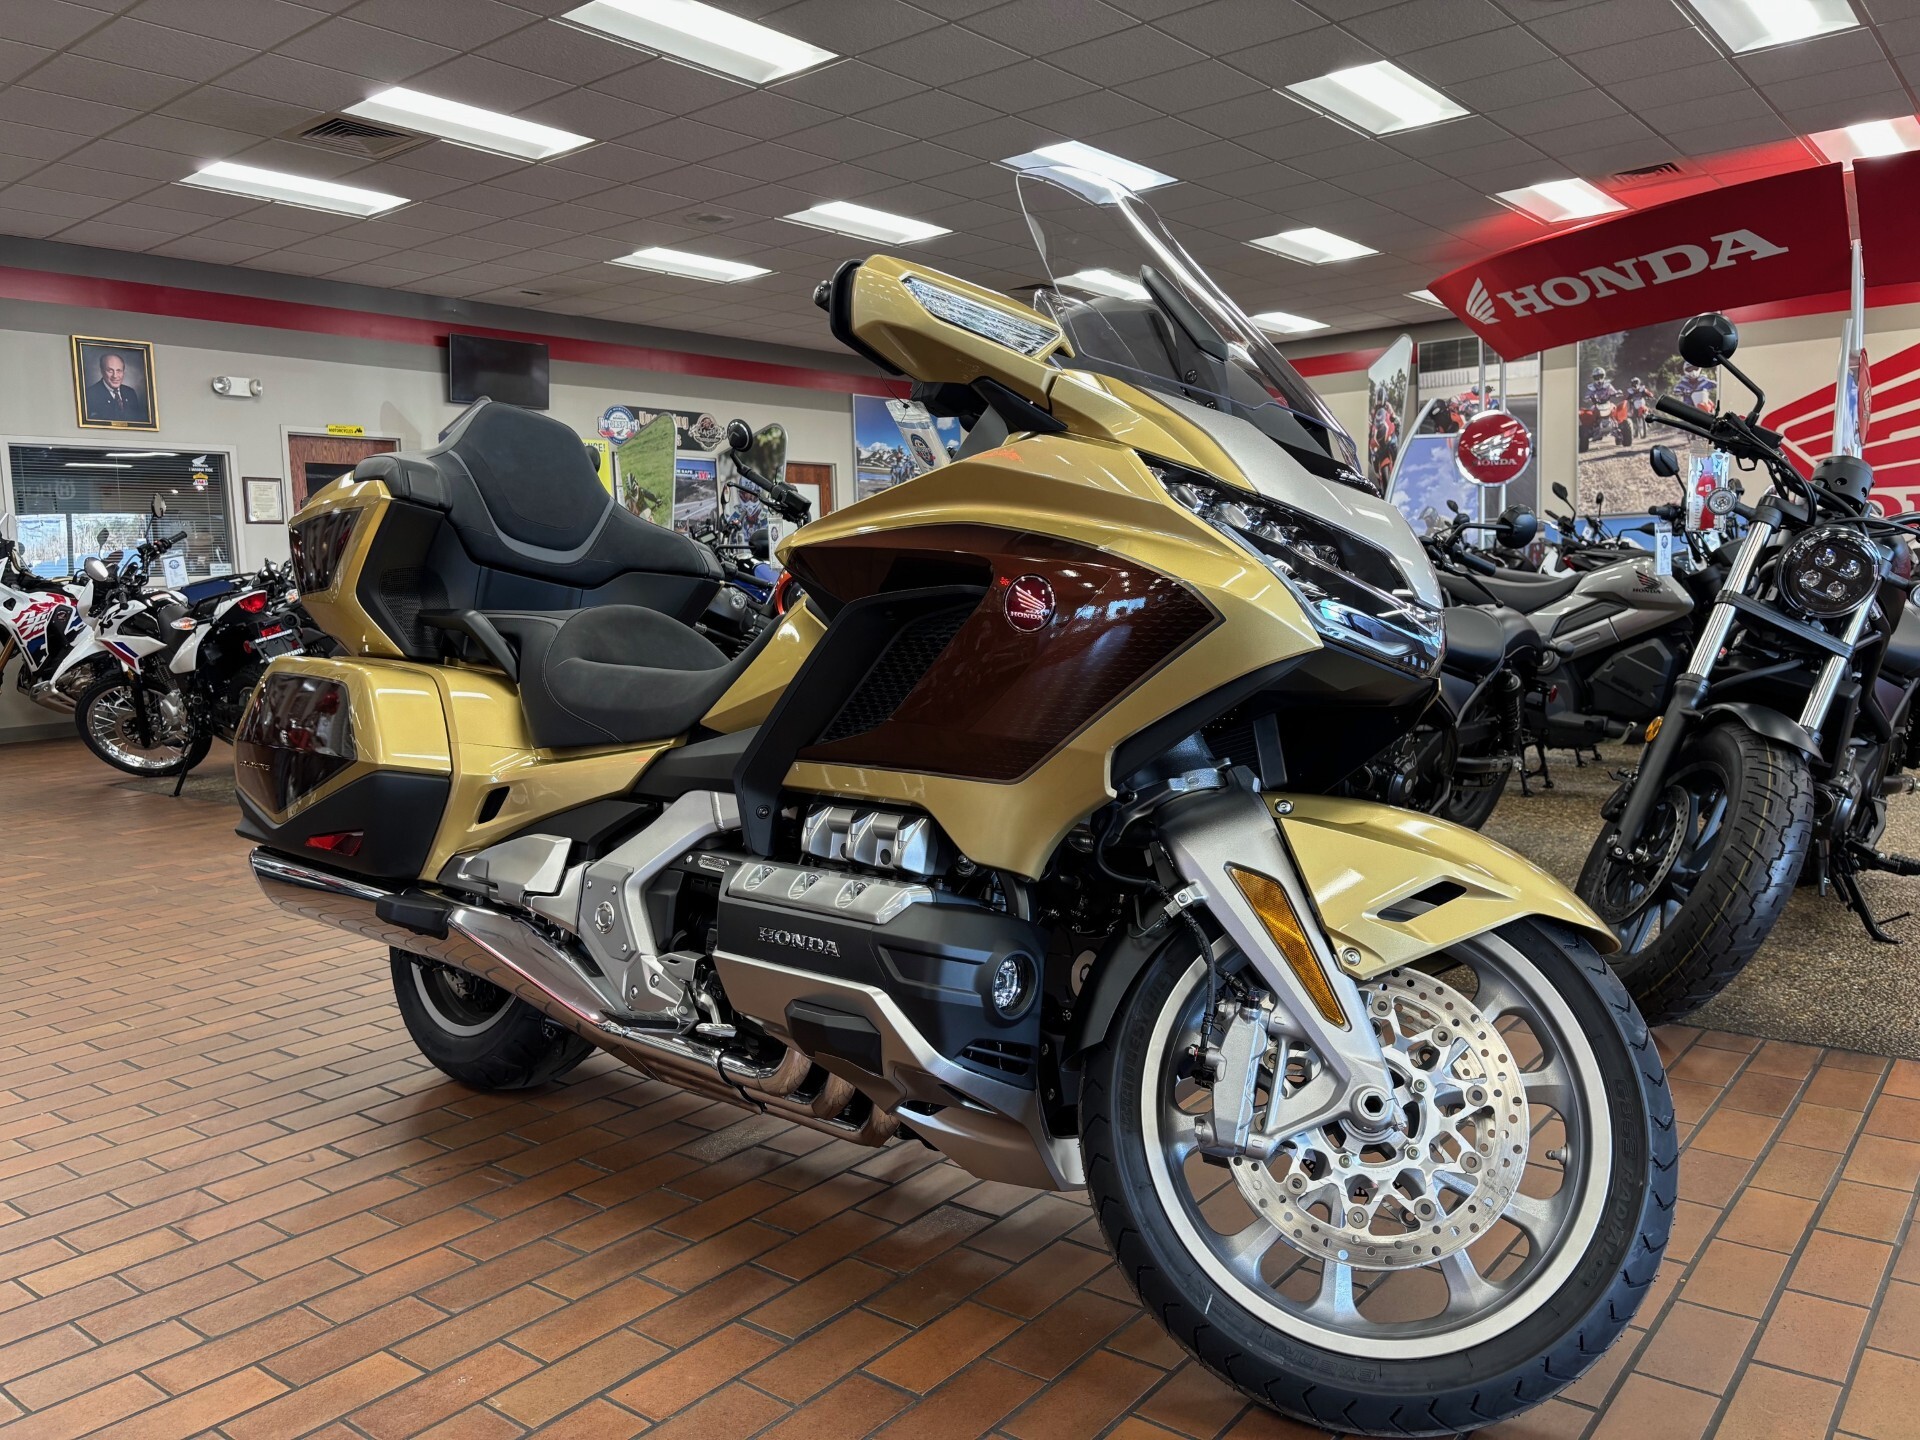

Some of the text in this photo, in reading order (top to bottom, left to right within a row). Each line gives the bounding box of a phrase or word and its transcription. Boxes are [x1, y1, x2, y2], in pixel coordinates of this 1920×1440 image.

[1496, 229, 1789, 317] HONDA
[1010, 611, 1044, 621] HONDA
[758, 926, 841, 957] HONDA
